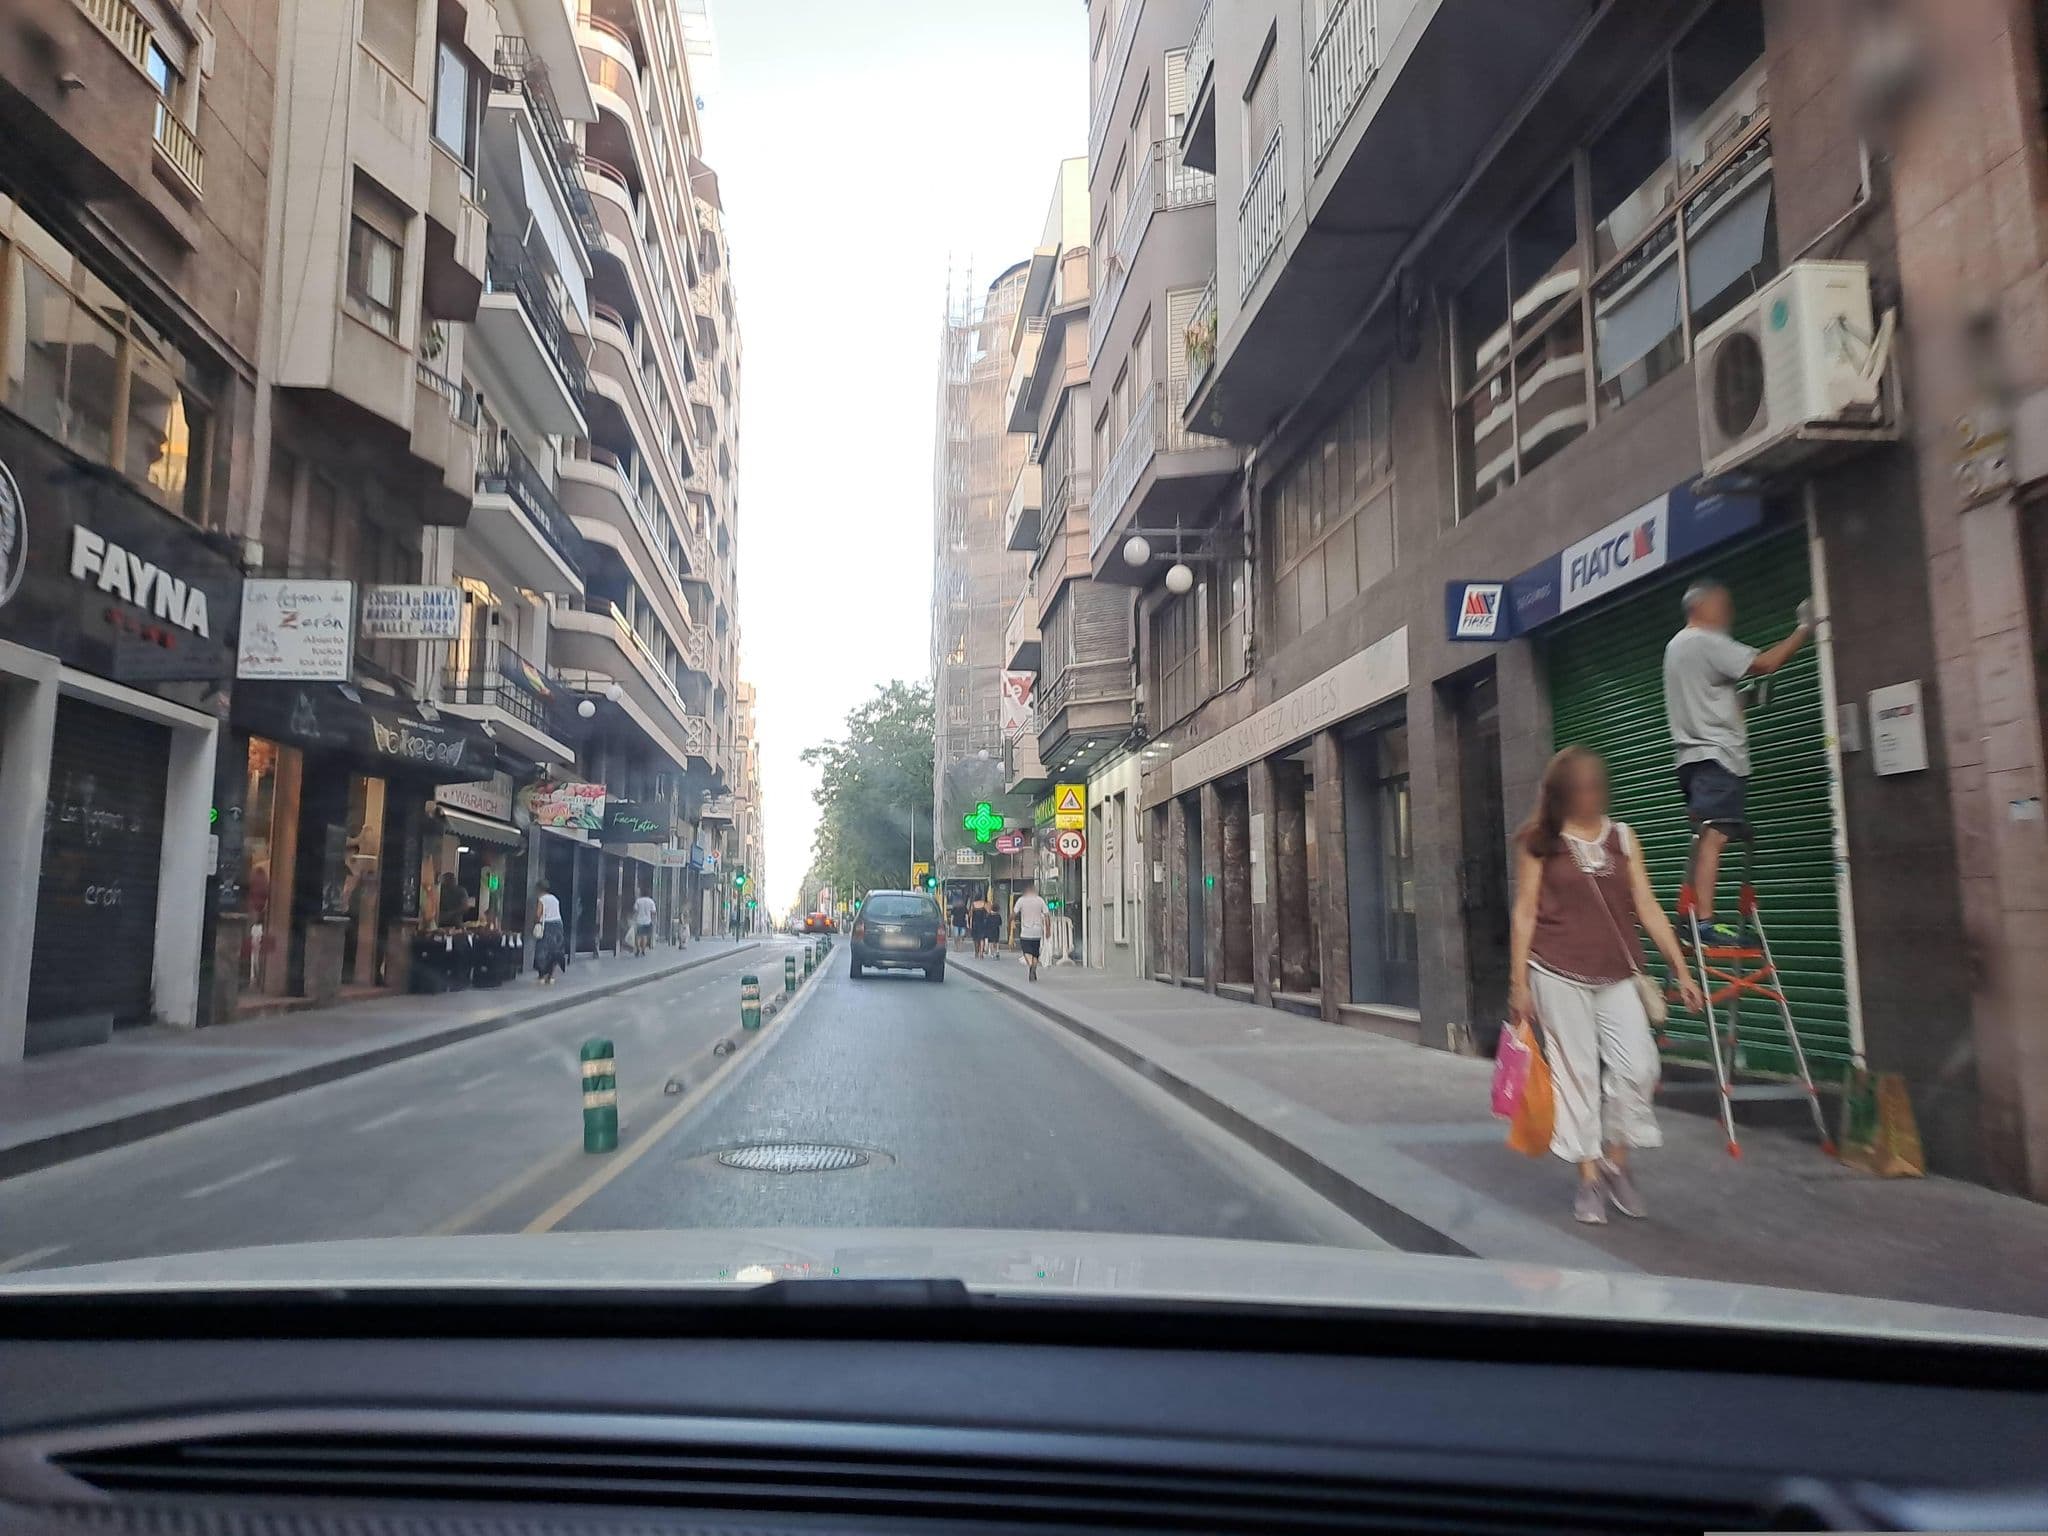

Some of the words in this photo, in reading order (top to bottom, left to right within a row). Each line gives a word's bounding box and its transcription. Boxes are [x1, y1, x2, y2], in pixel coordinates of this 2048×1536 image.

[1569, 531, 1630, 593] FIATC
[70, 524, 209, 639] FAYNA
[368, 591, 411, 606] ESCUELA
[423, 591, 454, 606] DANZA
[1290, 676, 1337, 732] QUILES
[456, 790, 498, 813] WARAICH
[1014, 837, 1021, 847] P
[1062, 838, 1079, 849] 30
